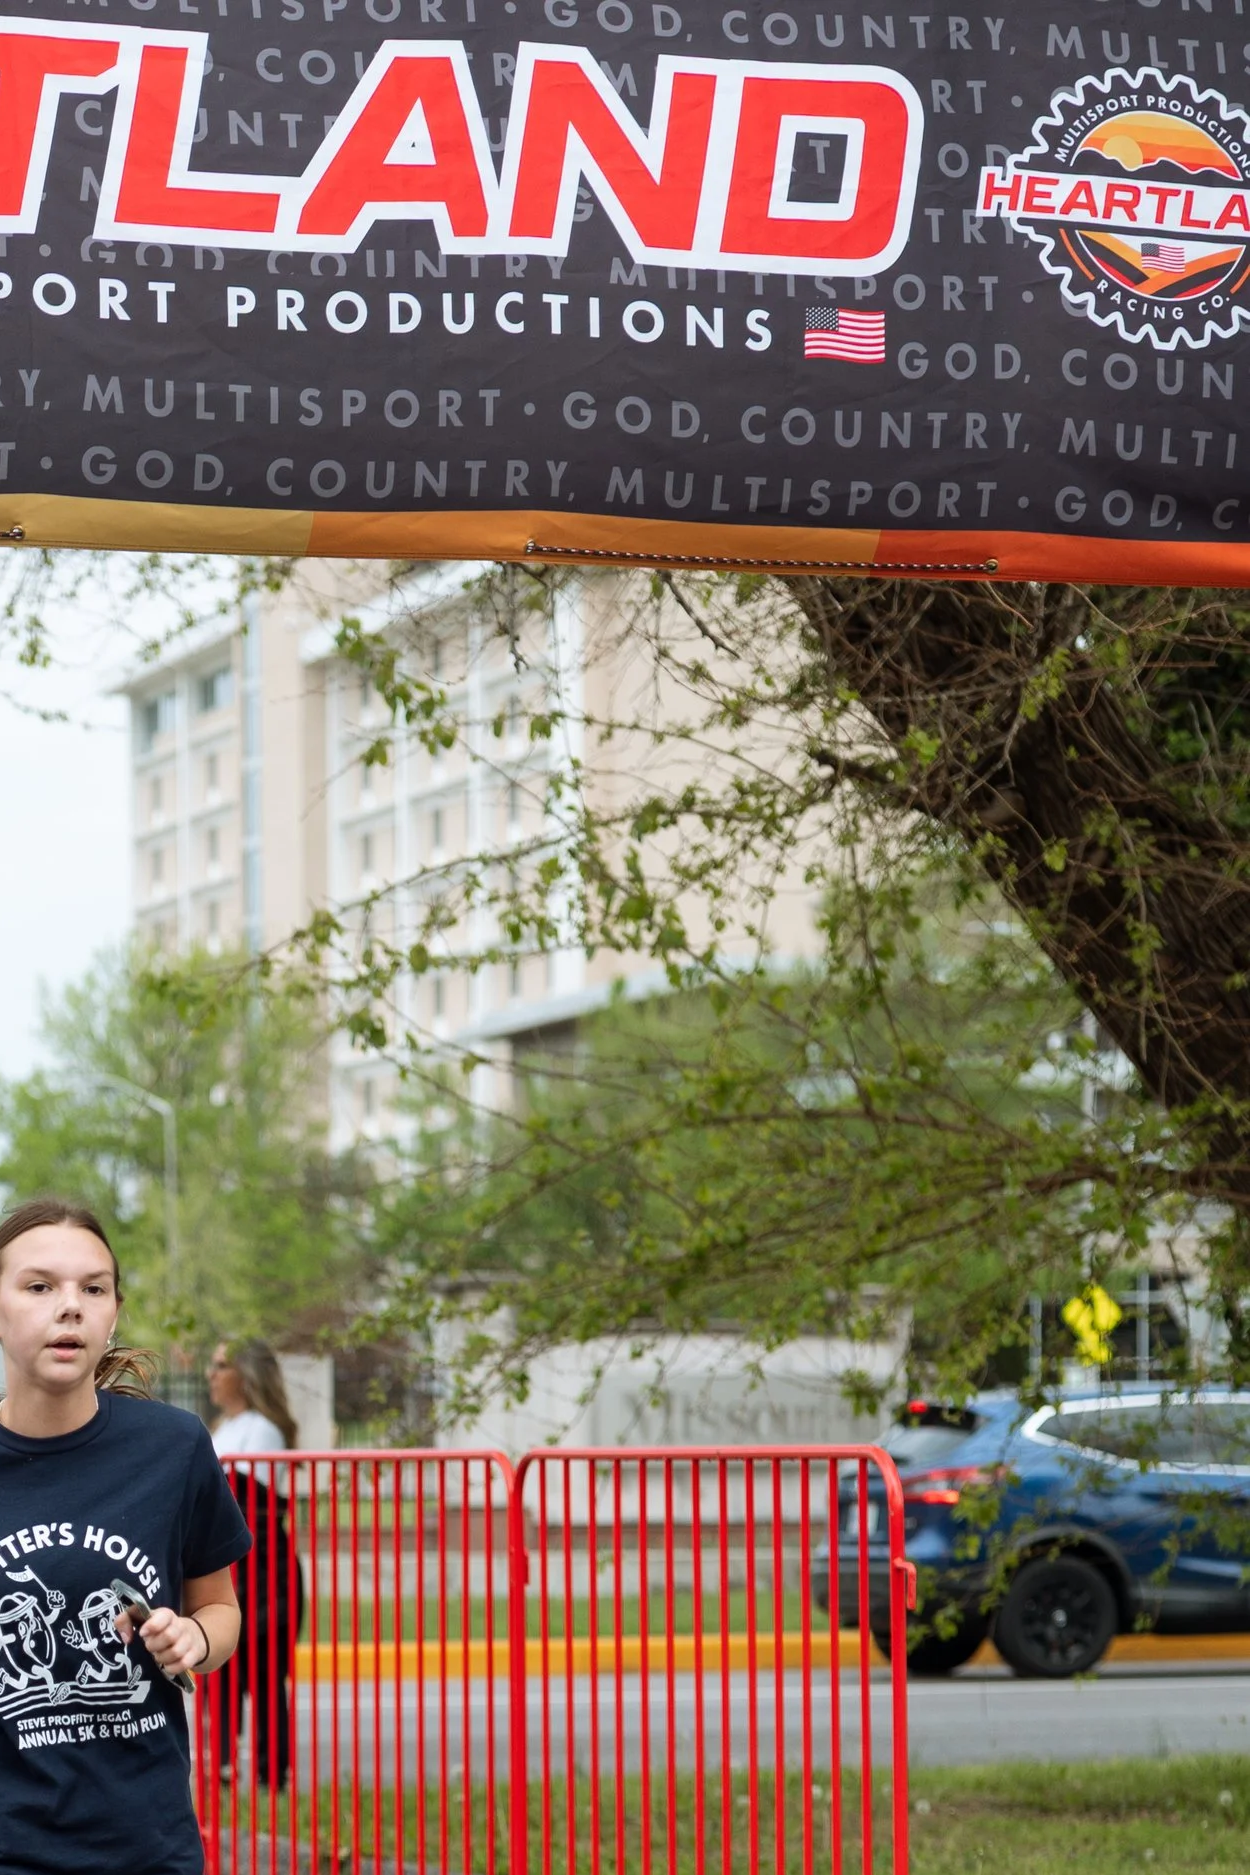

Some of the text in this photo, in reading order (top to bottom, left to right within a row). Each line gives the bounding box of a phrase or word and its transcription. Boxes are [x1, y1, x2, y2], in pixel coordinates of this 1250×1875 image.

[722, 10, 1015, 54] COUNTRY,
[1054, 94, 1139, 164] MULTISPORT
[227, 287, 771, 351] PRODUCTIONS
[1095, 276, 1231, 322] RACING CO.
[898, 342, 1030, 383] GOD,
[83, 374, 500, 427] MULTISPORT
[563, 391, 708, 442] GOD,
[741, 406, 1029, 452] COUNTRY,
[78, 446, 232, 499] GOD,
[267, 458, 574, 500] COUNTRY,
[603, 466, 997, 520] MULTISPORT
[1051, 482, 1186, 534] GOD,
[83, 1525, 161, 1600] HOUSE
[17, 1708, 132, 1731] STEVE PROFFITT LEGACY
[18, 1711, 167, 1750] ANNUAL 5K & FUN RUN
